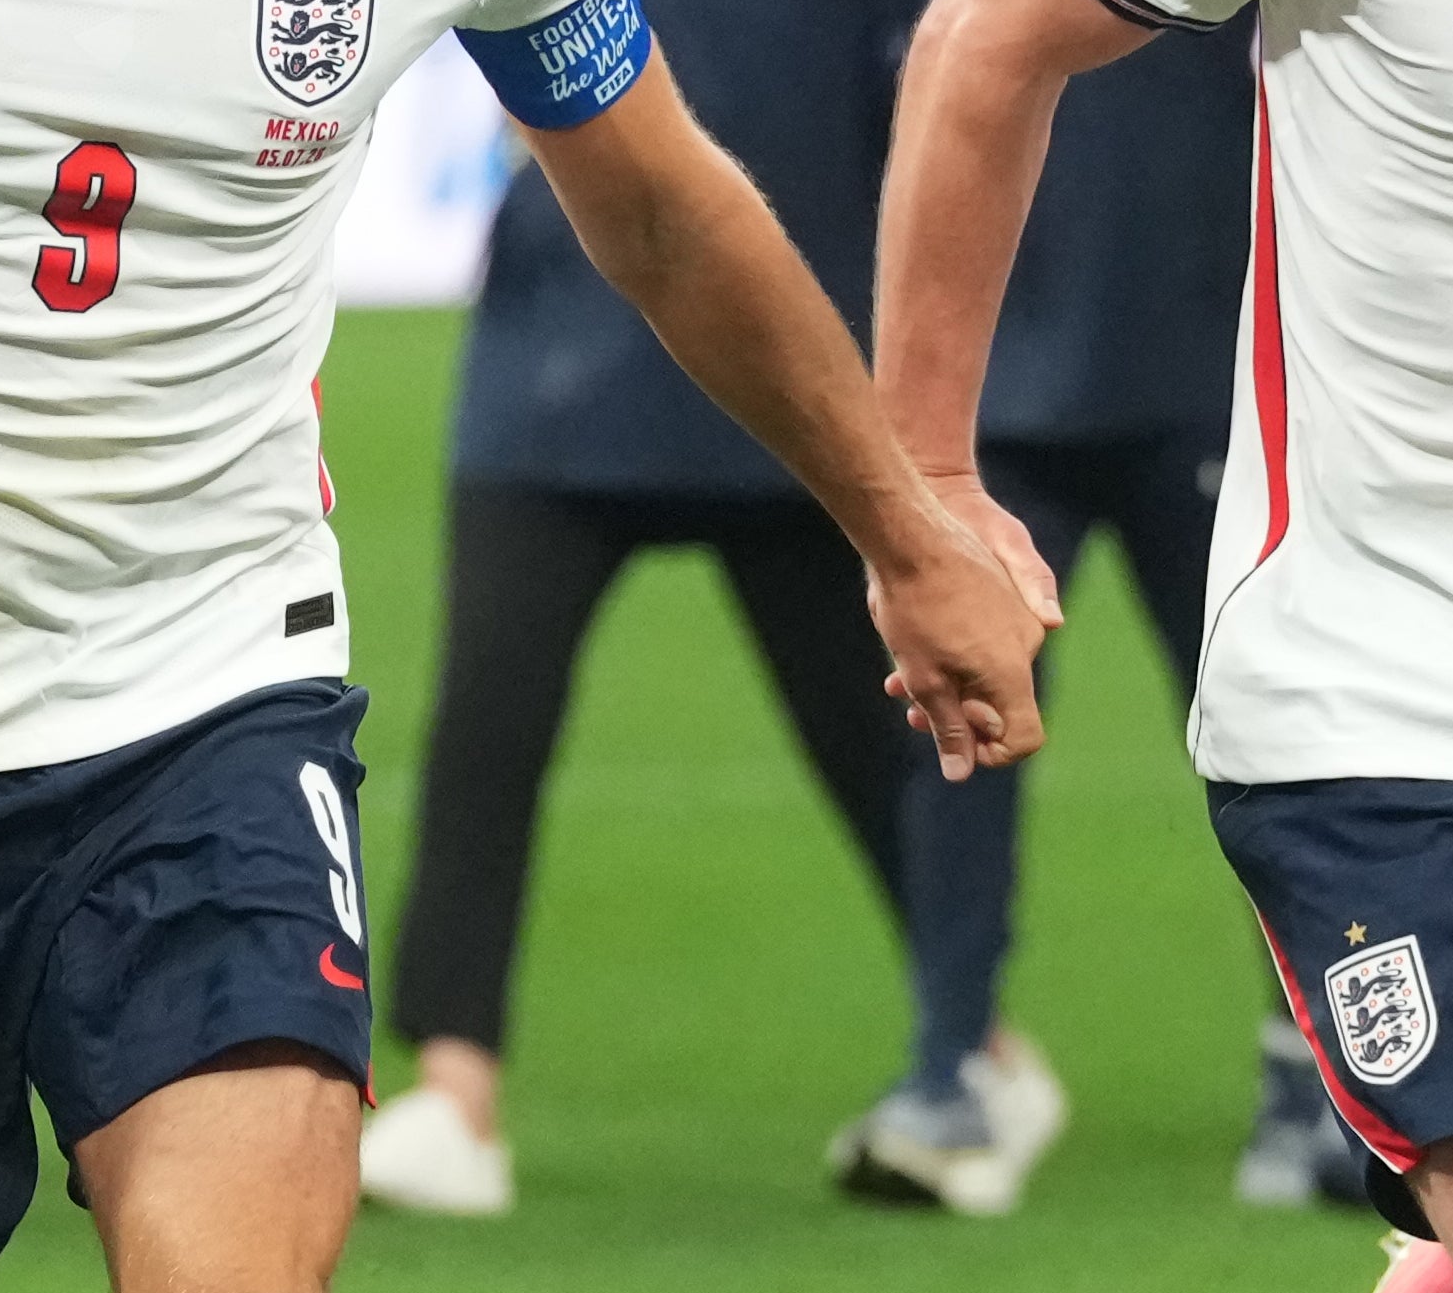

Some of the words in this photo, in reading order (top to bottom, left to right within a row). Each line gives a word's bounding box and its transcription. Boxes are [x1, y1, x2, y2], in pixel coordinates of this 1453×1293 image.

[544, 70, 594, 102] the
[591, 0, 640, 76] World
[597, 63, 633, 102] FIFA
[265, 119, 339, 142] MEXICO
[32, 140, 137, 313] 9
[299, 762, 363, 945] 9
